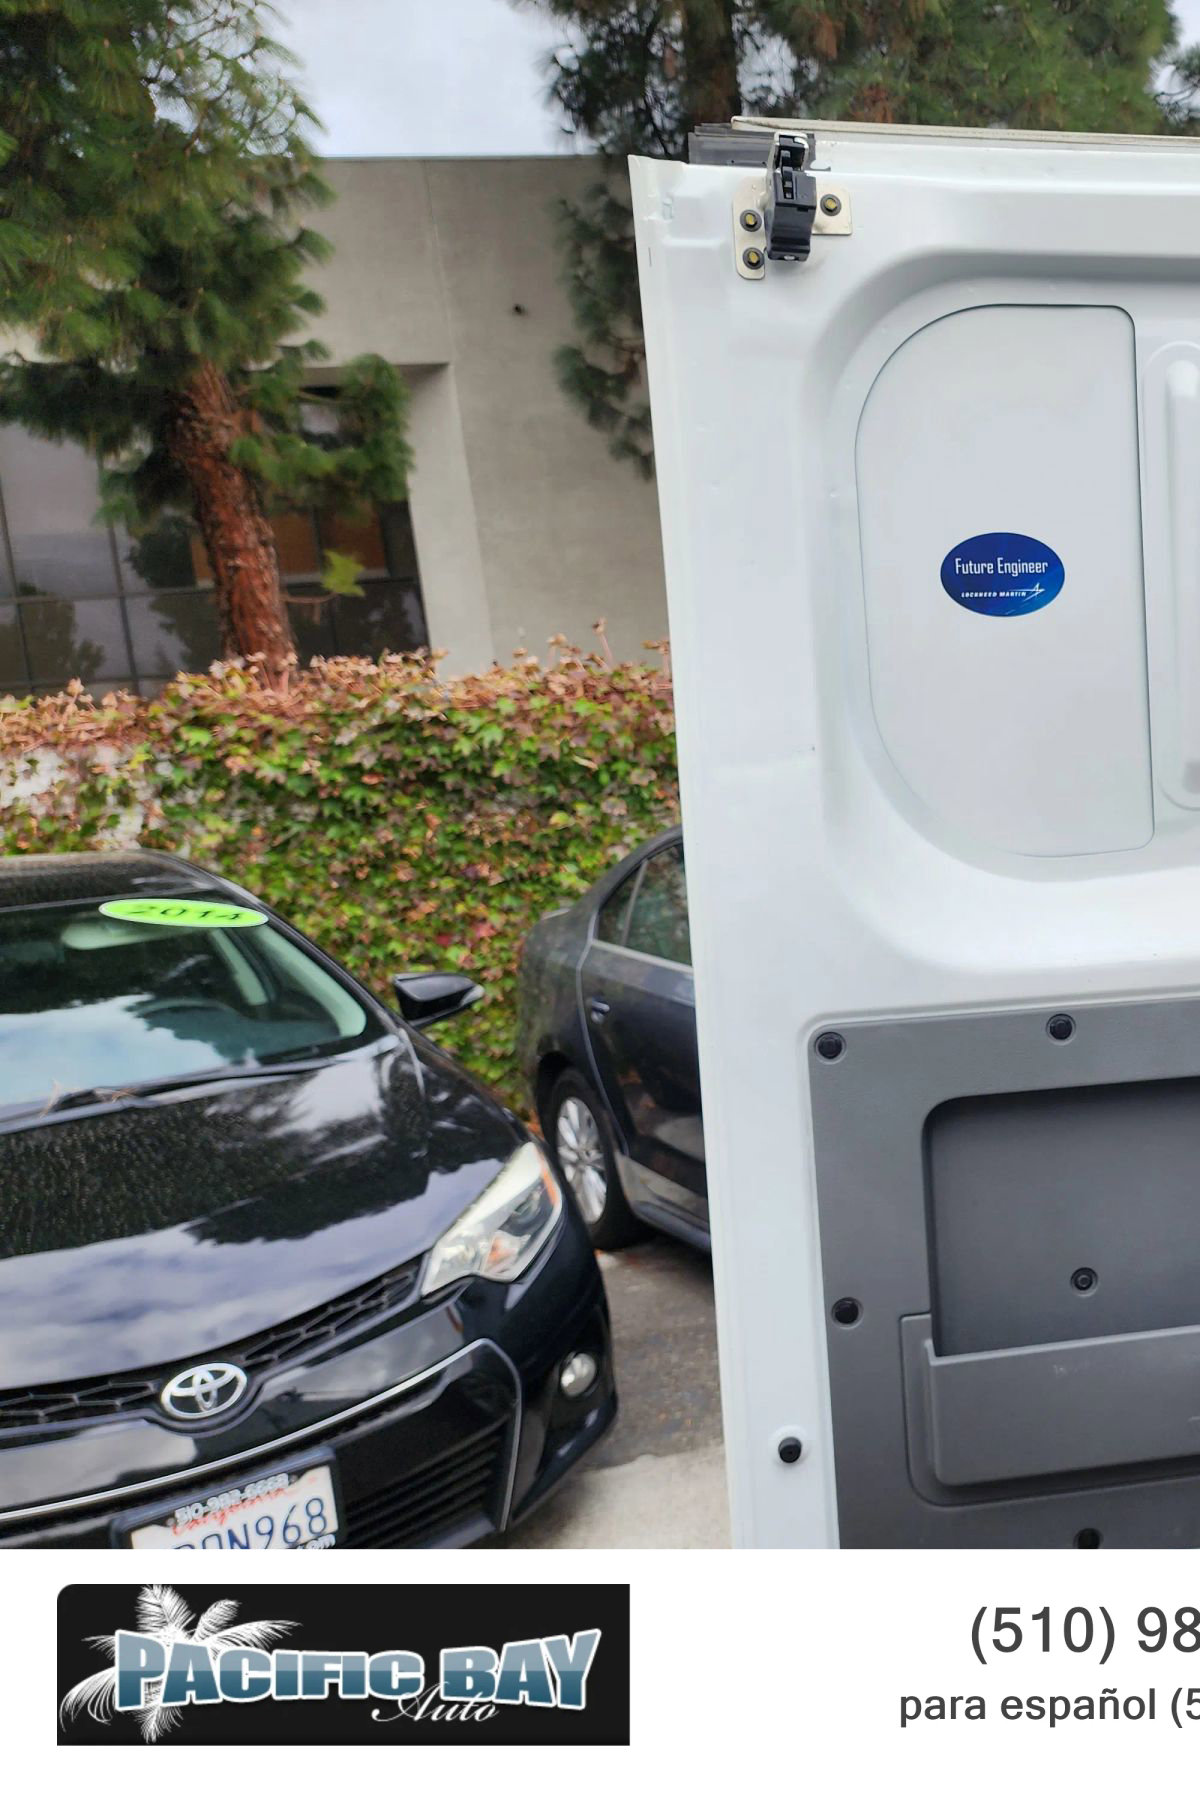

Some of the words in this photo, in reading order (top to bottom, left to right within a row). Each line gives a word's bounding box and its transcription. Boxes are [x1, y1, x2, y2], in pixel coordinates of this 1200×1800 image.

[955, 557, 994, 575] Future
[997, 557, 1048, 577] Engineer
[125, 905, 243, 921] 2014
